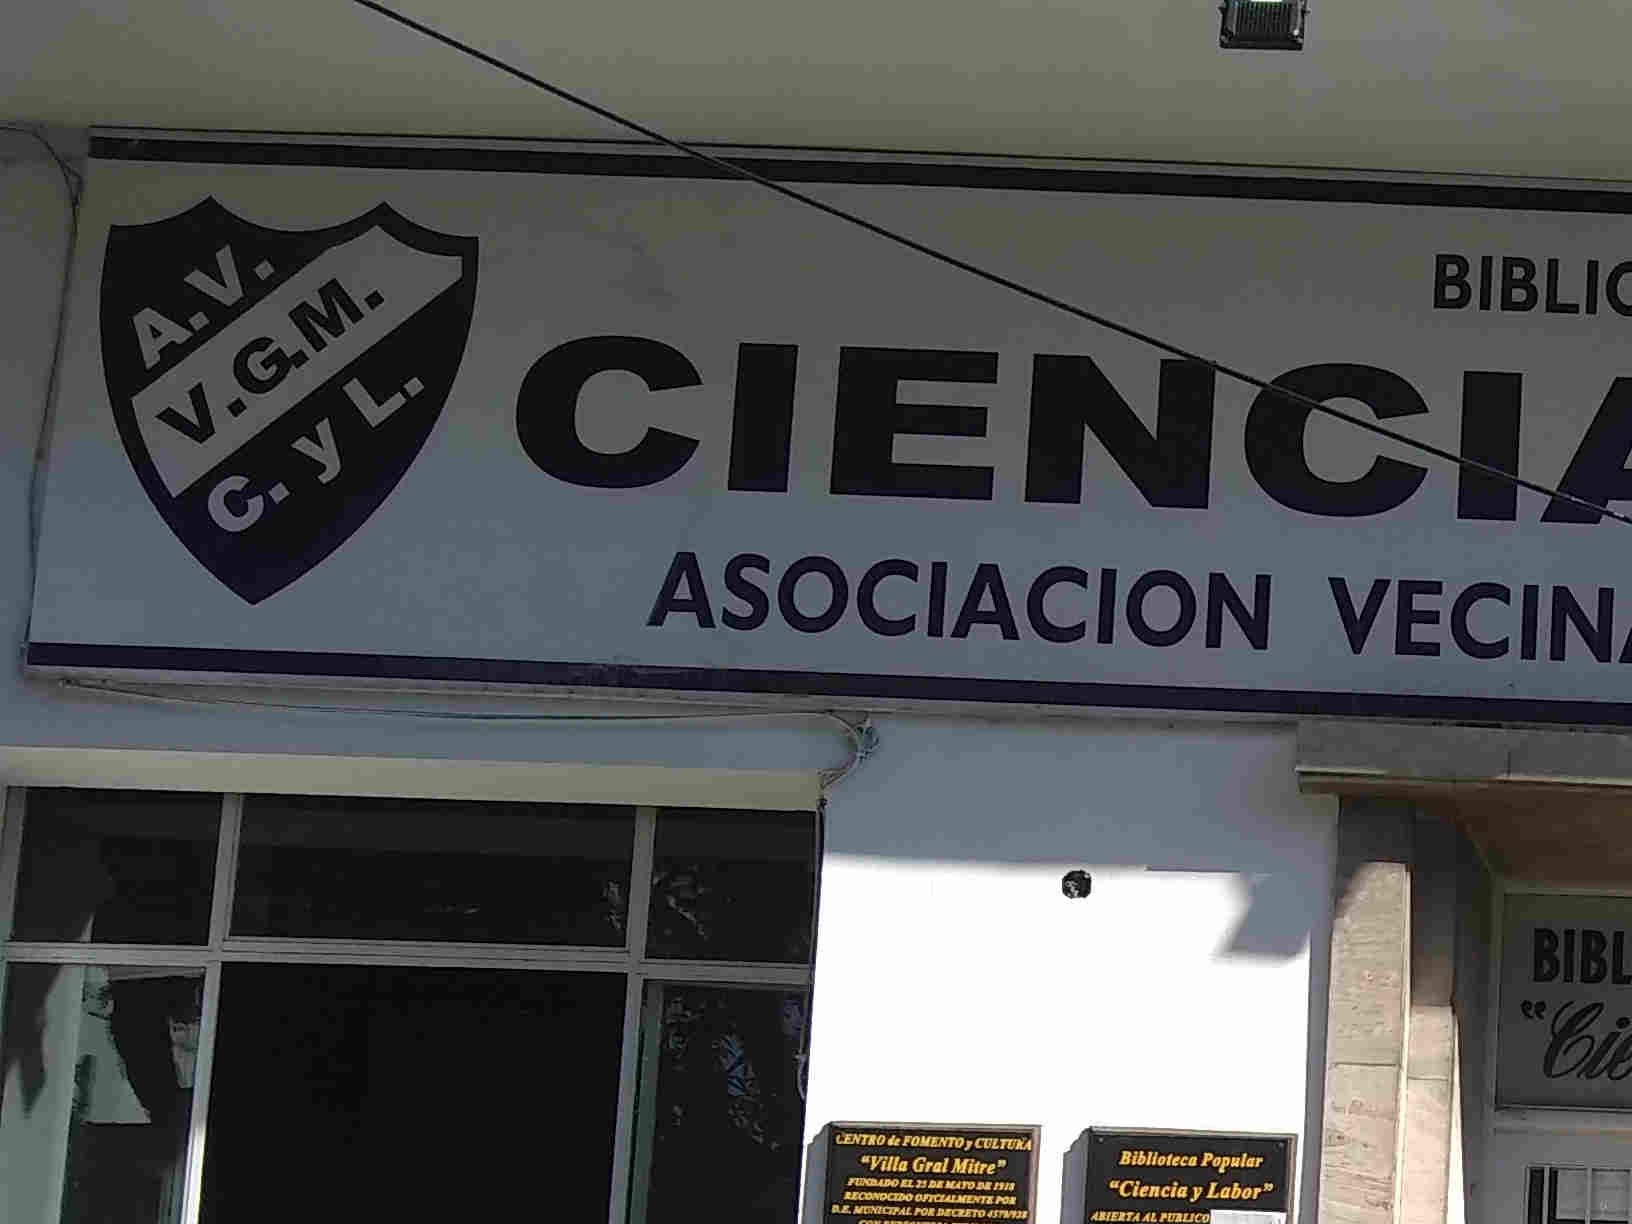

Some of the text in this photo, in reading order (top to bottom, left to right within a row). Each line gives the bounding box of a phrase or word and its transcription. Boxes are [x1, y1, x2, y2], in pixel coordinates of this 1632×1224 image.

[133, 244, 275, 371] A.V.
[155, 278, 385, 444] V.G.M.
[646, 550, 1272, 651] ASOCIACION
[836, 1133, 1033, 1151] CENTRO de FOMENTO y CULTURA
[912, 1157, 948, 1174] Gral
[1119, 1151, 1264, 1173] Biblioteca Popular
[847, 1177, 899, 1188] FUNDADO
[900, 1179, 914, 1189] EL
[928, 1180, 944, 1190] DE
[944, 1181, 975, 1191] MAYO
[976, 1182, 992, 1191] DE
[843, 1191, 1016, 1206] RECONOCIDO OFICIALMENTE POR
[1190, 1186, 1204, 1202] y
[853, 1205, 912, 1217] MUNICIPAL
[914, 1208, 936, 1218] POR
[937, 1208, 985, 1219] DECRETO
[1090, 1211, 1210, 1224] ABIERTA AL PUBLICO
